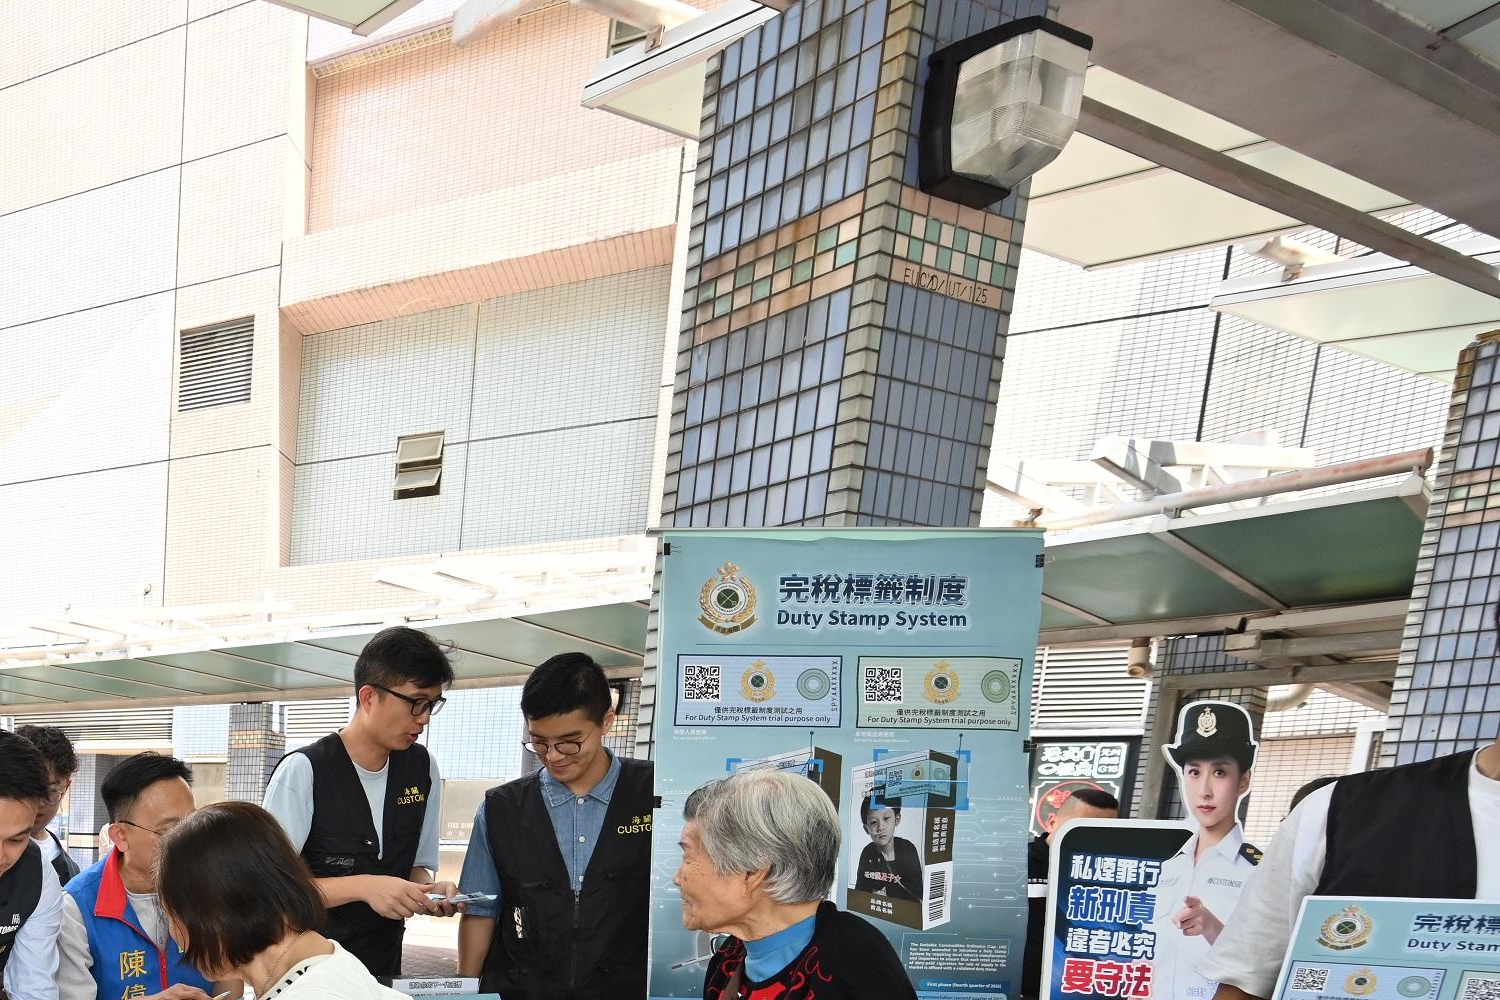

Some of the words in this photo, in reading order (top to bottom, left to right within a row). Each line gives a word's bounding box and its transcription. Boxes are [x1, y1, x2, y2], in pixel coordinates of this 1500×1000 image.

[779, 574, 967, 606] 完稅標籤制度
[778, 609, 823, 629] Duty
[828, 610, 889, 630] Stamp
[896, 611, 966, 630] System
[699, 715, 715, 723] Duty
[717, 715, 739, 723] Stamp
[741, 715, 766, 723] System
[925, 717, 949, 725] System
[998, 719, 1011, 727] only
[1071, 855, 1160, 886] 私煙罪行
[1067, 885, 1157, 924] 新刑責
[1066, 928, 1156, 958] 違者必究
[1407, 938, 1451, 951] Duty
[1061, 958, 1153, 997] 要守法
